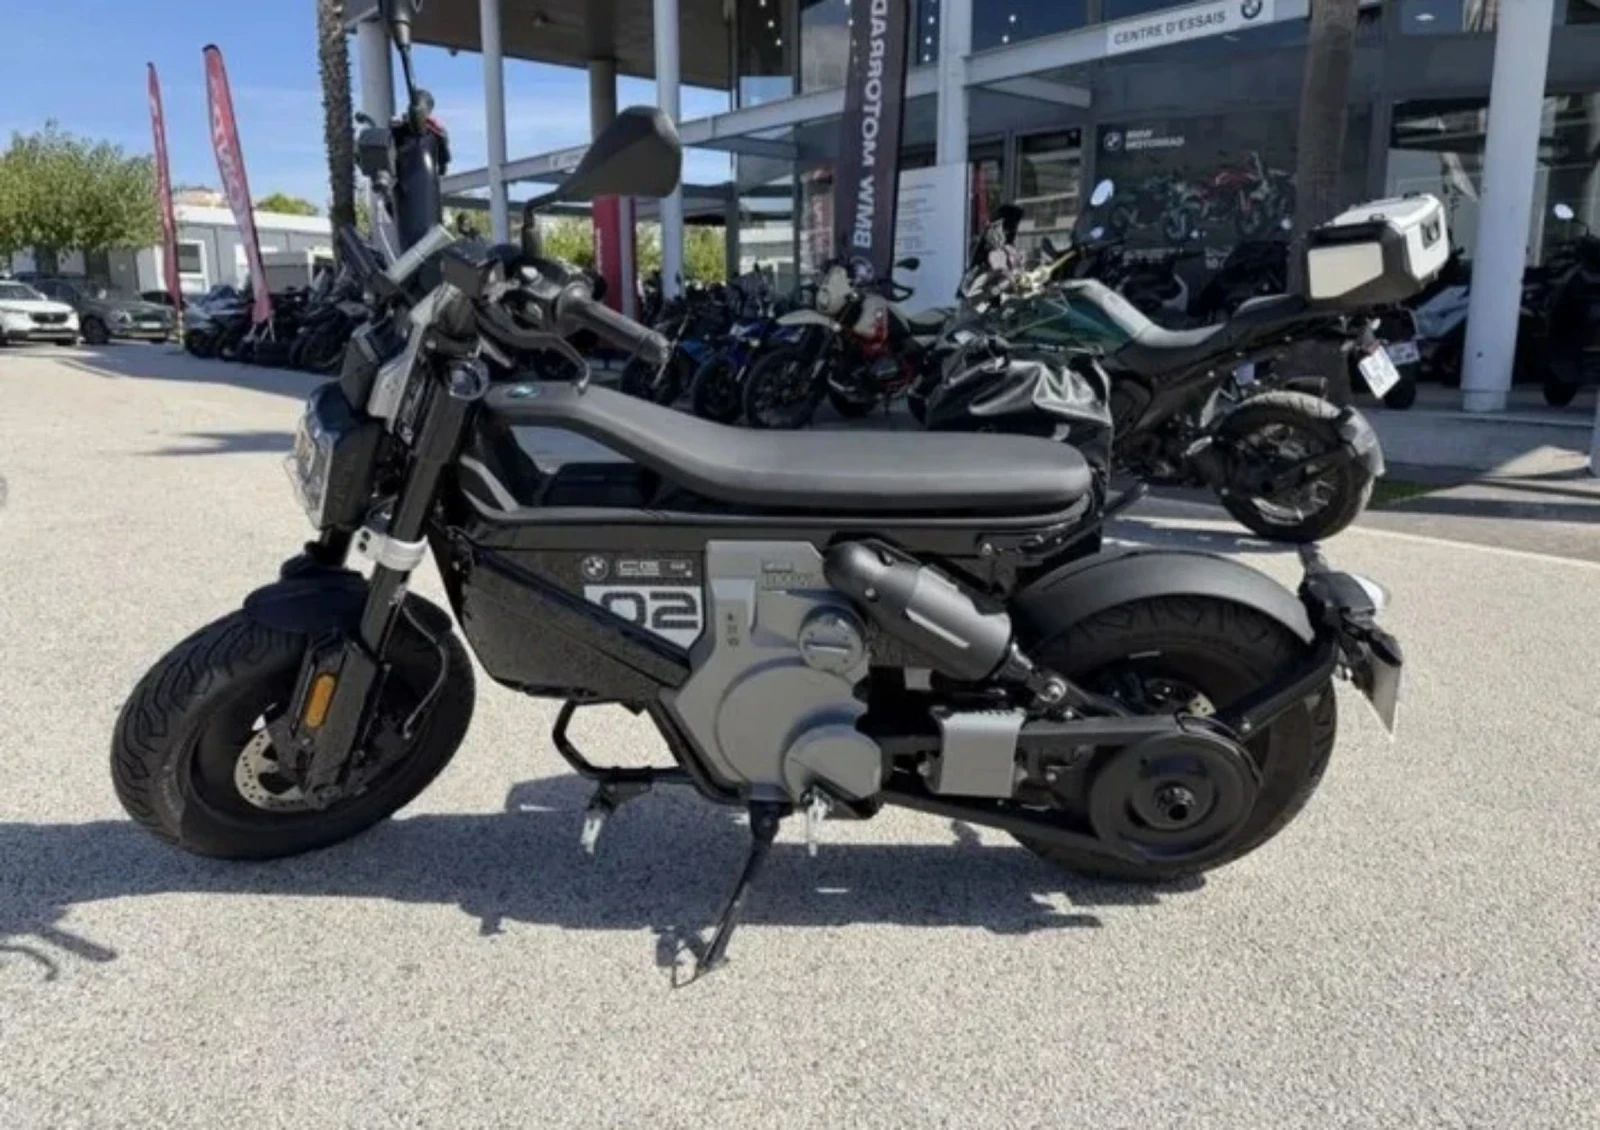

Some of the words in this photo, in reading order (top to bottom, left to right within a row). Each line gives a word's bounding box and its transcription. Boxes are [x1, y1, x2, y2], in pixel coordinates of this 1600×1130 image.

[1114, 25, 1162, 46] CENTRE
[1166, 11, 1226, 34] D'ESSAIS
[601, 591, 698, 629] 02
